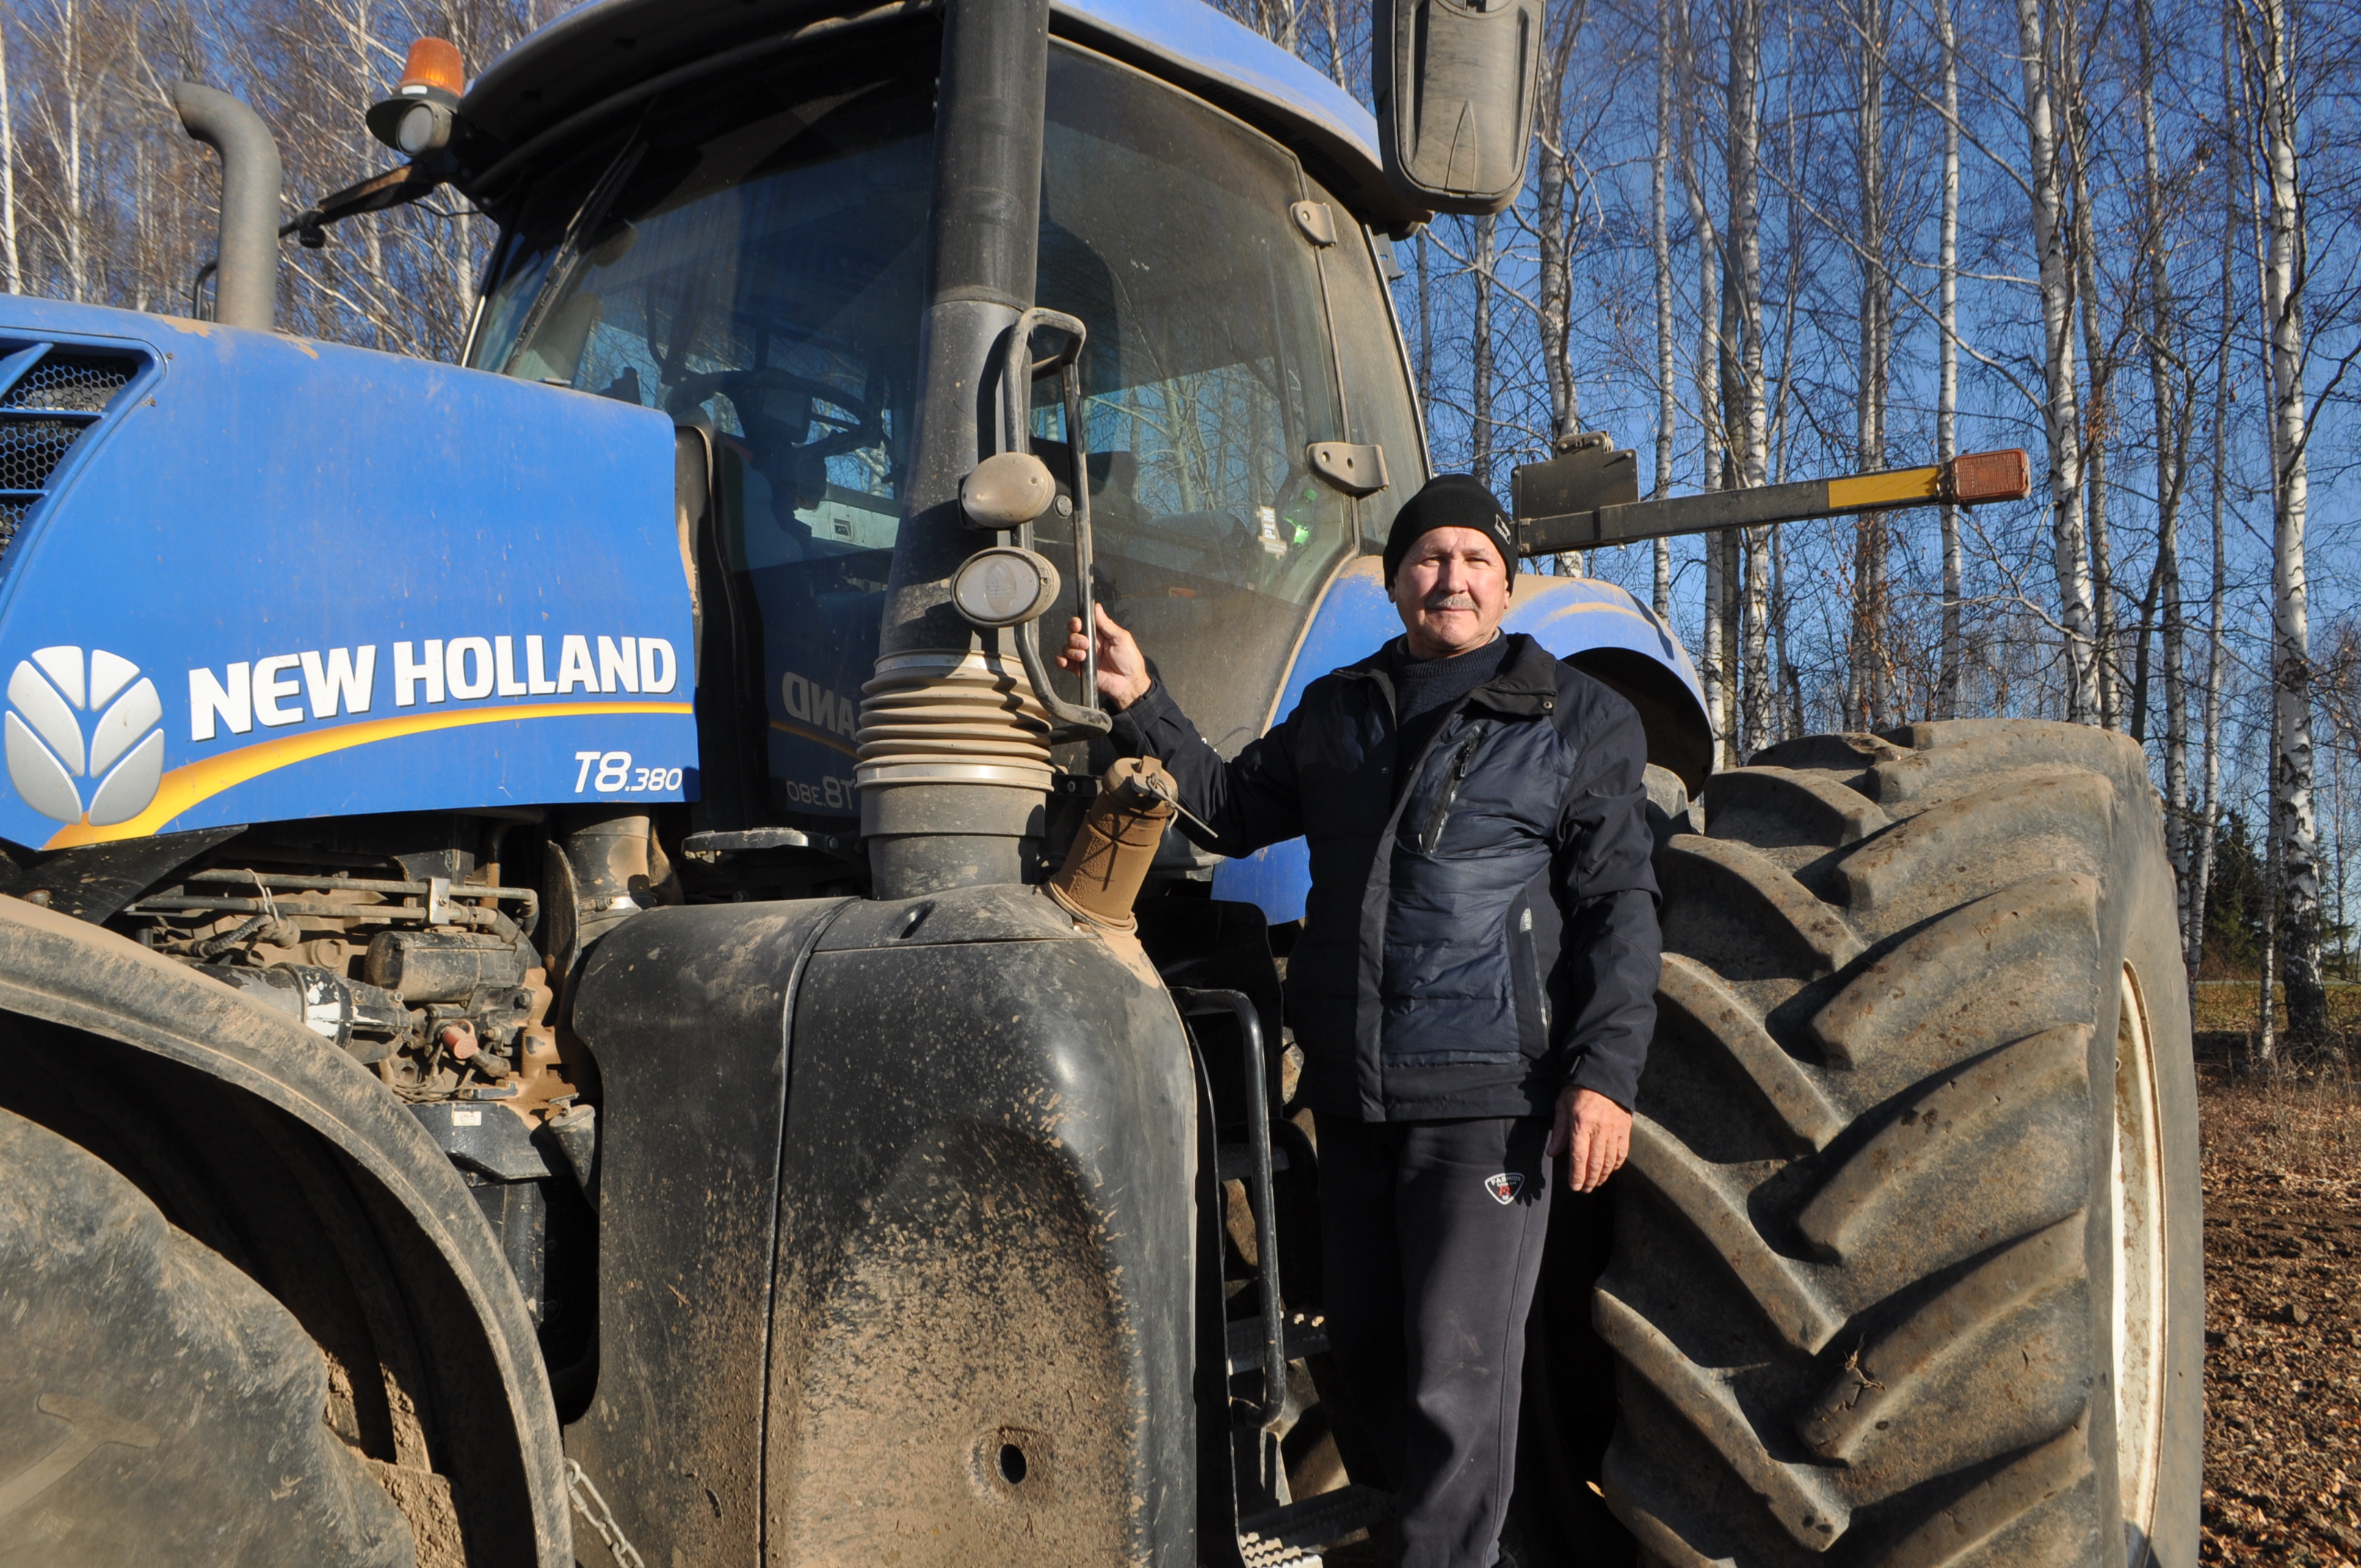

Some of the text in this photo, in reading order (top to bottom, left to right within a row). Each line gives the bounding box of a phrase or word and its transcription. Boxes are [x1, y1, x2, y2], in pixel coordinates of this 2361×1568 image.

[1263, 508, 1277, 540] PLM
[189, 634, 678, 741] NEW HOLLAND
[574, 750, 683, 794] T8.380
